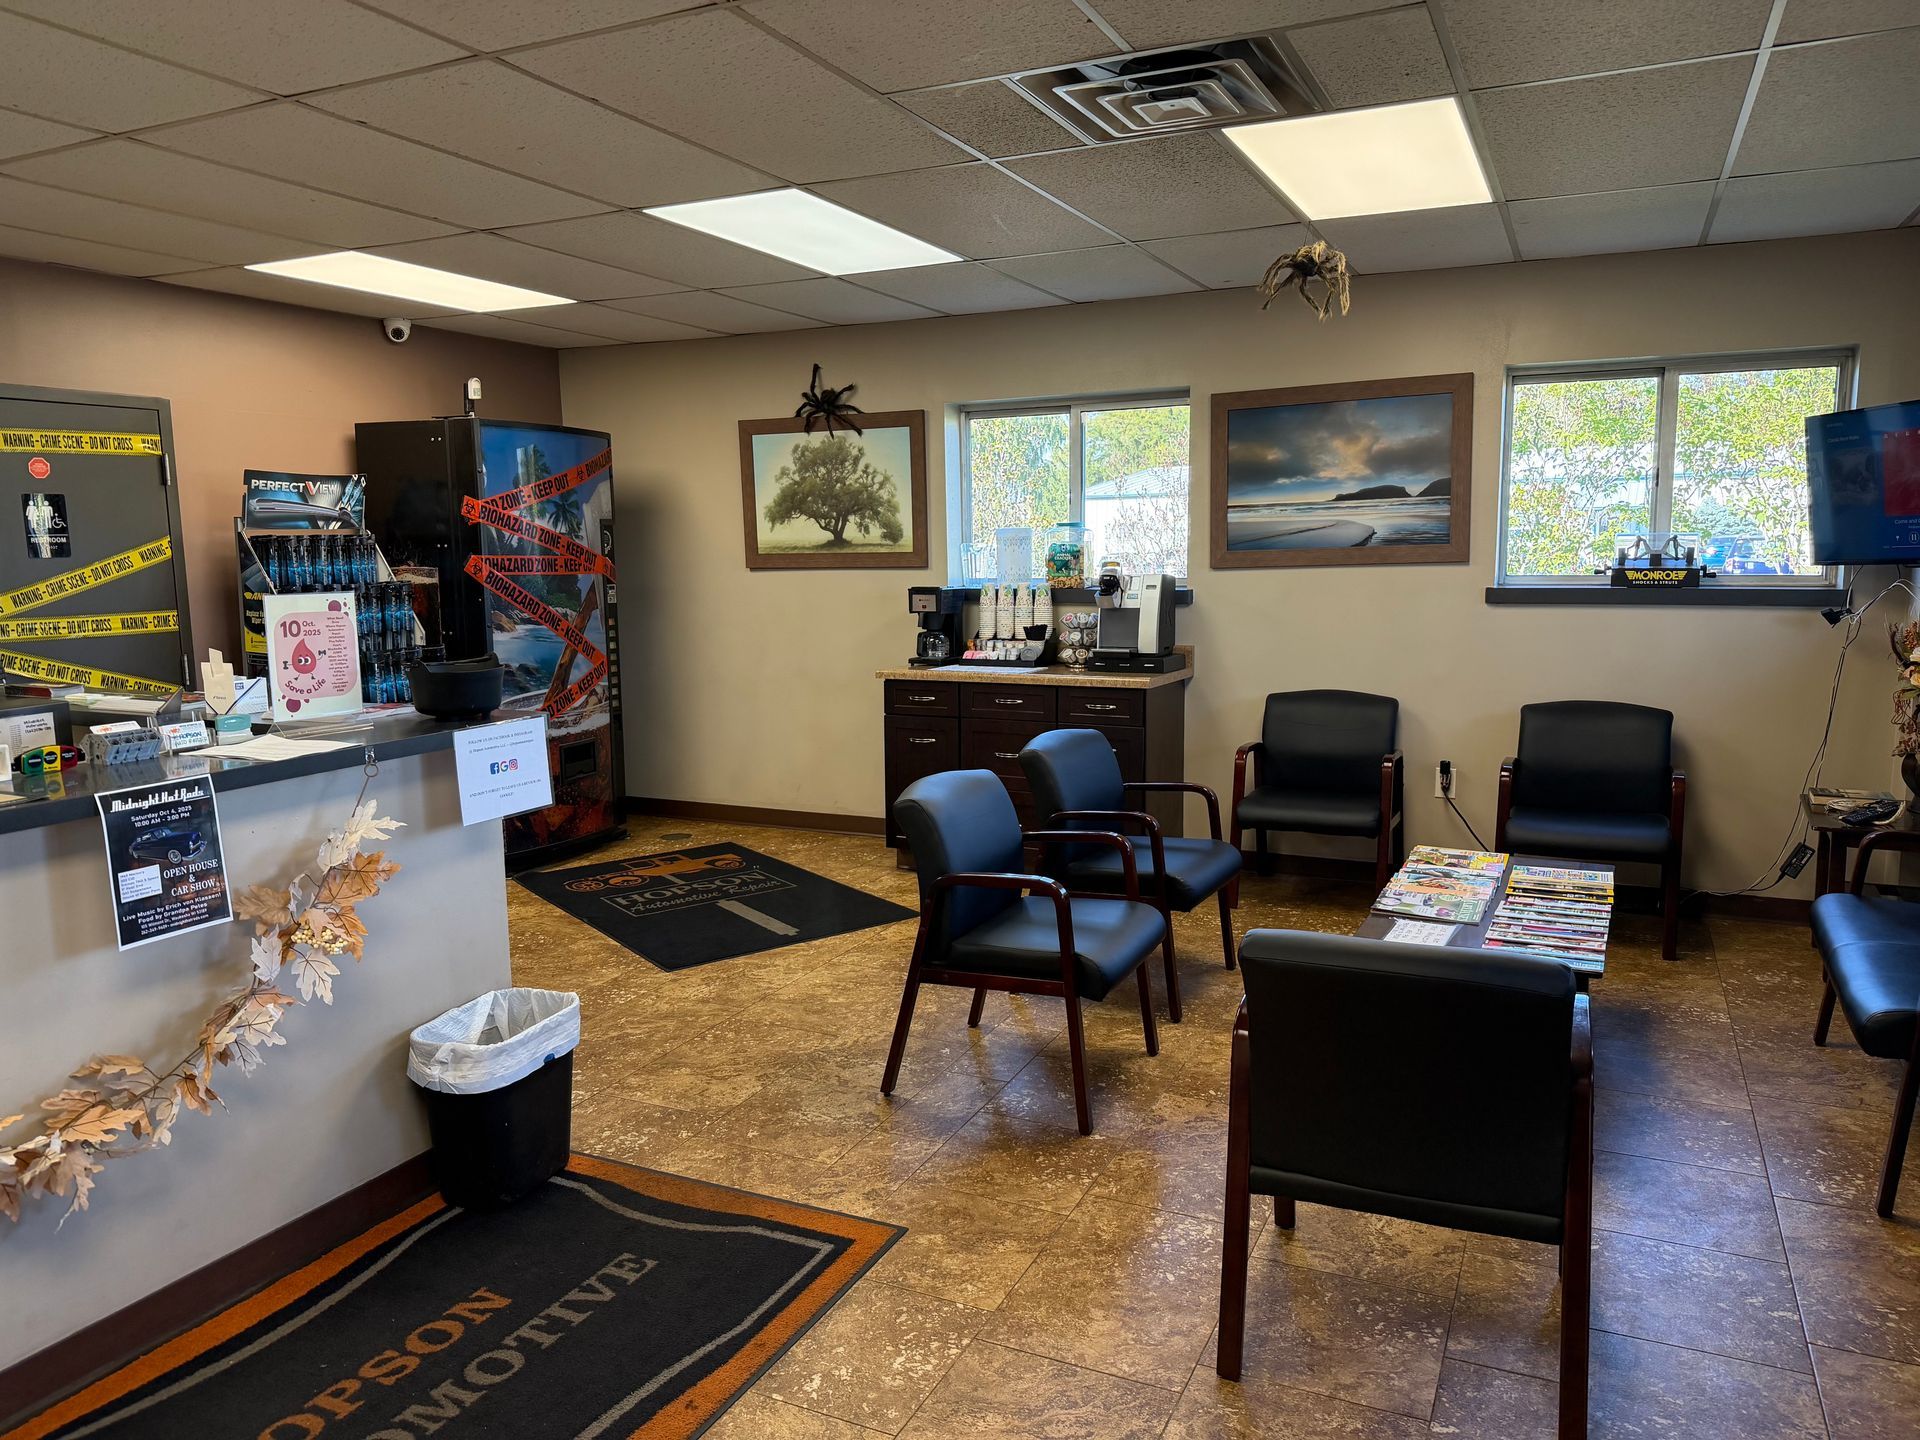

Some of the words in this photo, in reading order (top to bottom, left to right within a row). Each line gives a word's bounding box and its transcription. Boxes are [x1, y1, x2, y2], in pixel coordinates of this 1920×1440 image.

[2, 433, 34, 448] WARNING
[40, 434, 62, 449] CRIME
[62, 436, 84, 449] SCENE
[89, 436, 98, 450] DO
[99, 437, 111, 450] NOT
[112, 437, 134, 450] CROSS
[531, 480, 554, 500] KEEP
[554, 473, 570, 492] OUT
[479, 505, 537, 539] BIOHAZARD
[538, 528, 562, 550] ZONE
[566, 542, 585, 560] KEEP
[584, 552, 597, 566] OUT
[138, 544, 167, 563] WARNING
[535, 558, 558, 573] ZONE
[10, 587, 43, 608] WARNING
[46, 580, 69, 597] CRIME
[66, 572, 90, 590] SCENE
[91, 568, 102, 582] DO
[101, 563, 114, 579] NOT
[113, 556, 134, 574] CROSS
[1633, 571, 1678, 580] MONROE
[120, 616, 148, 630] WARNING
[152, 614, 171, 628] CRIME
[485, 573, 540, 614] BIOHAZARD
[539, 608, 561, 632] ZONE
[564, 626, 583, 647] KEEP
[582, 642, 595, 660] OUT
[16, 622, 38, 636] CRIME
[39, 621, 61, 636] SCENE
[66, 620, 78, 634] DO
[78, 620, 90, 633] NOT
[91, 619, 112, 632] CROSS
[280, 620, 301, 637] 10
[18, 657, 41, 675] SCENE
[46, 664, 56, 677] DO
[57, 666, 70, 680] NOT
[70, 668, 92, 684] CROSS
[285, 680, 305, 694] Save
[313, 678, 326, 691] Life
[554, 689, 576, 713] ZONE
[578, 676, 596, 694] KEEP
[594, 662, 607, 680] OUT
[110, 794, 162, 813] Midnight
[161, 790, 179, 803] Hot
[180, 786, 205, 802] Rods
[131, 812, 158, 822] Saturday
[163, 866, 188, 879] OPEN
[189, 859, 218, 873] HOUSE
[188, 874, 196, 882] &
[171, 886, 189, 897] CAR
[190, 878, 216, 892] SHOW
[614, 872, 767, 906] HOPSON
[631, 892, 721, 913] Automotive
[722, 880, 781, 894] Repair
[137, 910, 156, 918] Music
[165, 903, 181, 911] Erich
[138, 916, 154, 924] Food
[164, 907, 190, 918] Grandpa
